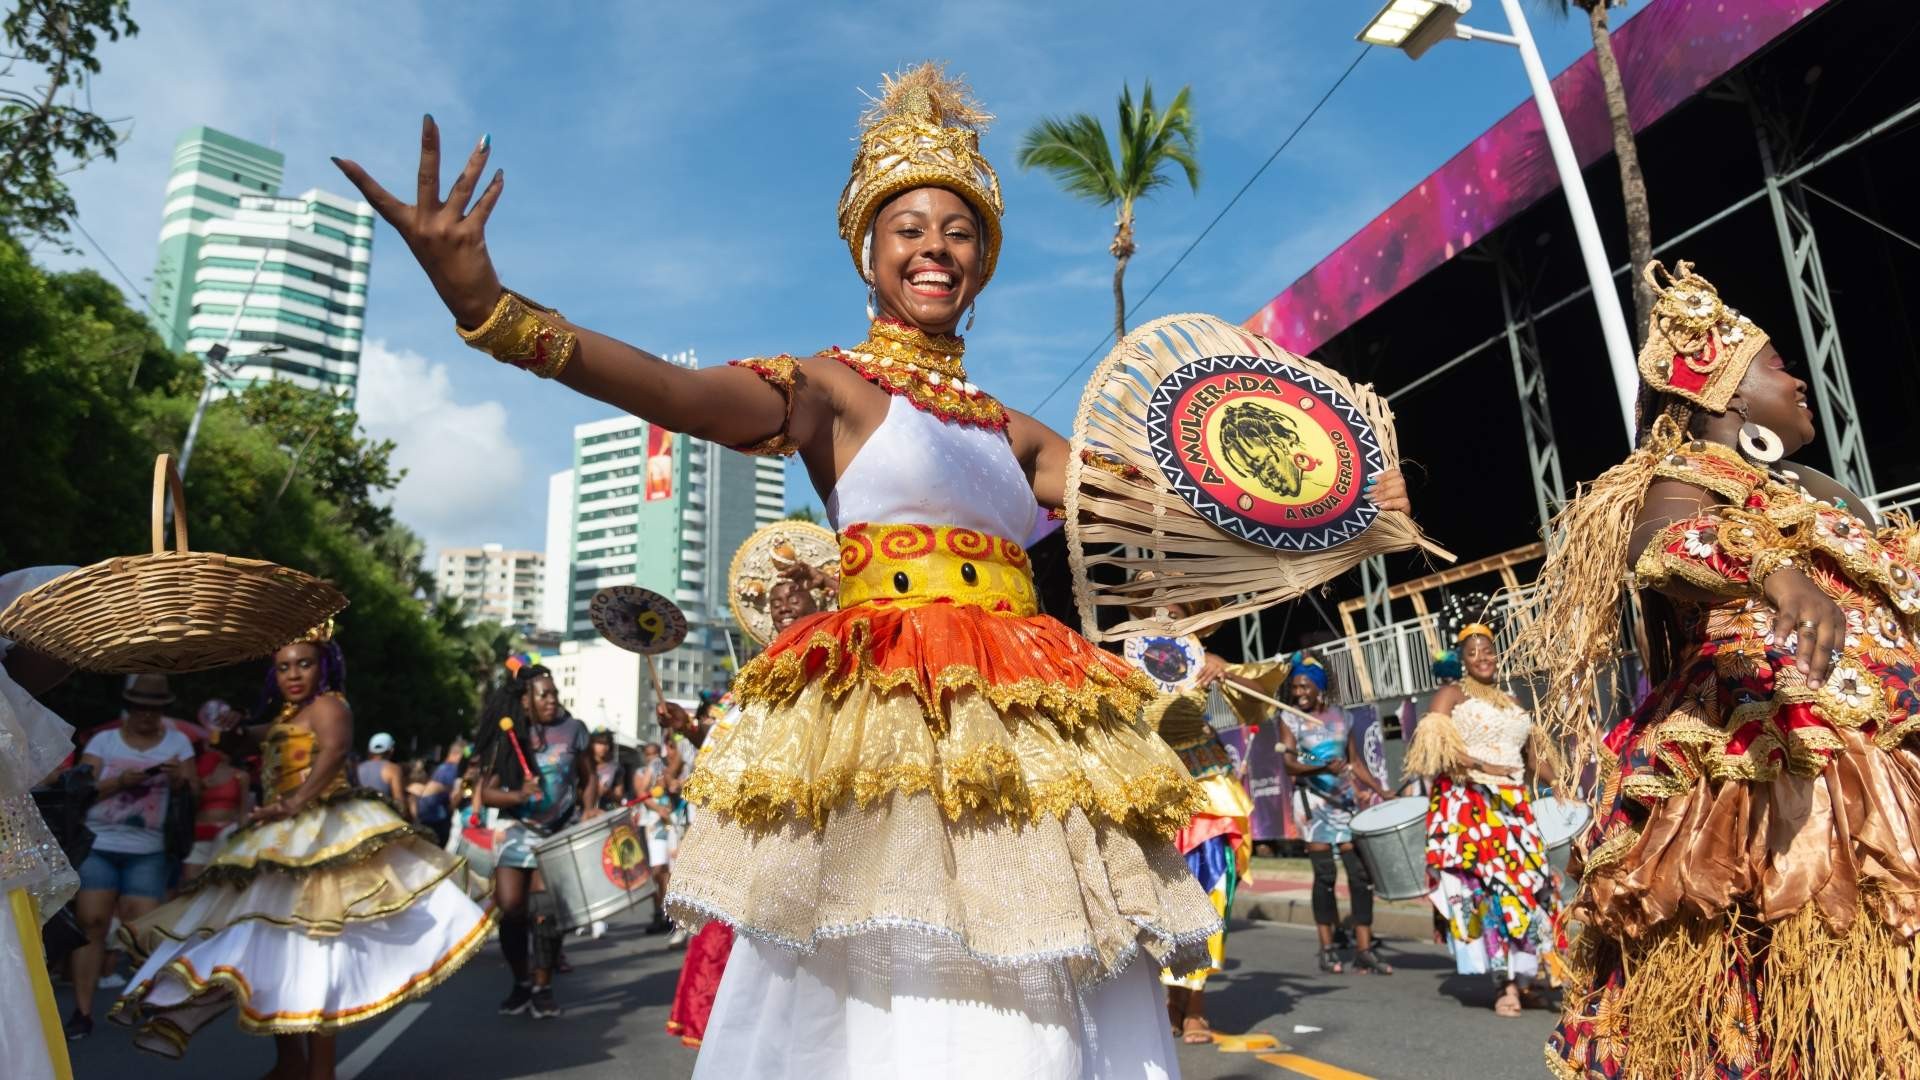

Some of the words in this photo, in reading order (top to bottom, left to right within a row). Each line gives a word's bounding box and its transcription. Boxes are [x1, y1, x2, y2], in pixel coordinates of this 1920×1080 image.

[1180, 375, 1283, 465] MULHERADA
[1202, 466, 1225, 486] A
[1285, 507, 1298, 521] A
[1301, 495, 1342, 520] NOVA
